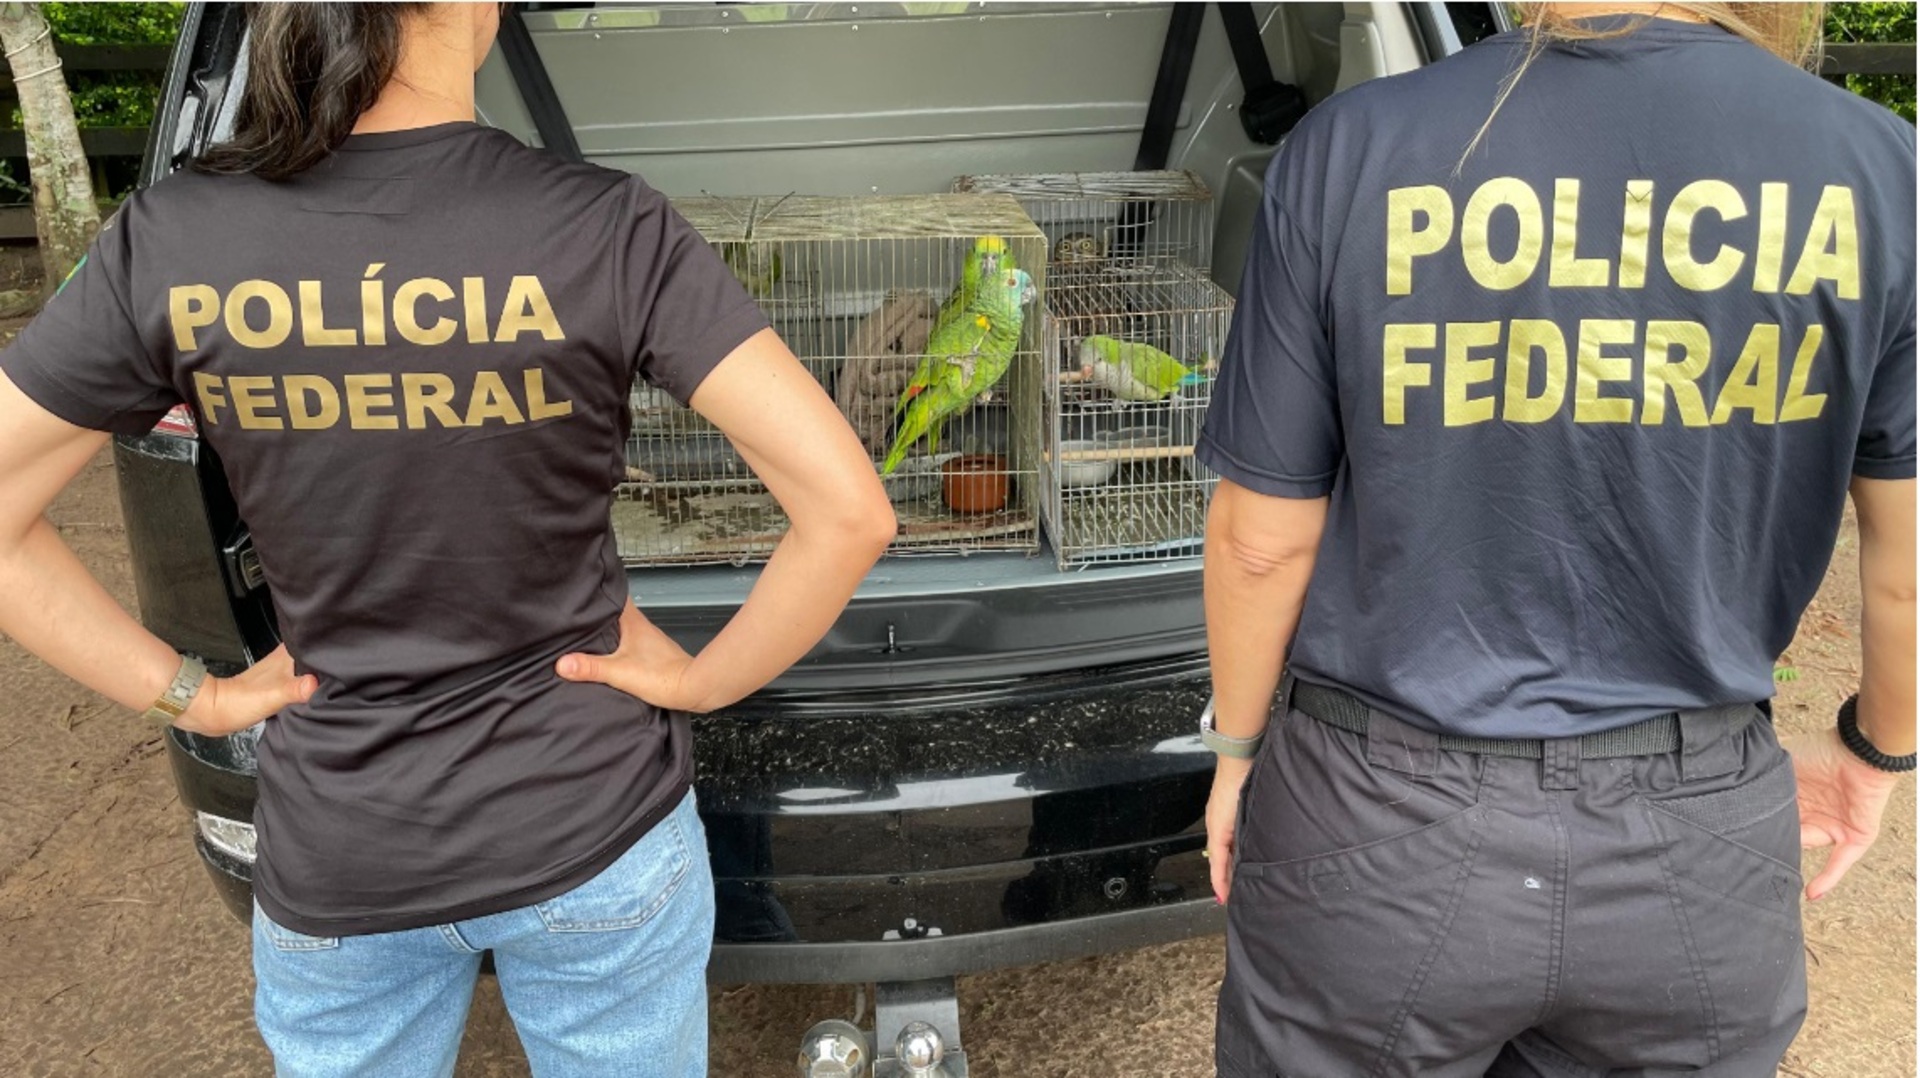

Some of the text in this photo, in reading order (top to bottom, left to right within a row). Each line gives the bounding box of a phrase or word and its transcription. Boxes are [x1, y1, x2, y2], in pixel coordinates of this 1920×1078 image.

[169, 263, 566, 352] POLÍCIA
[193, 368, 573, 430] FEDERAL
[1383, 319, 1828, 427] FEDERAL
